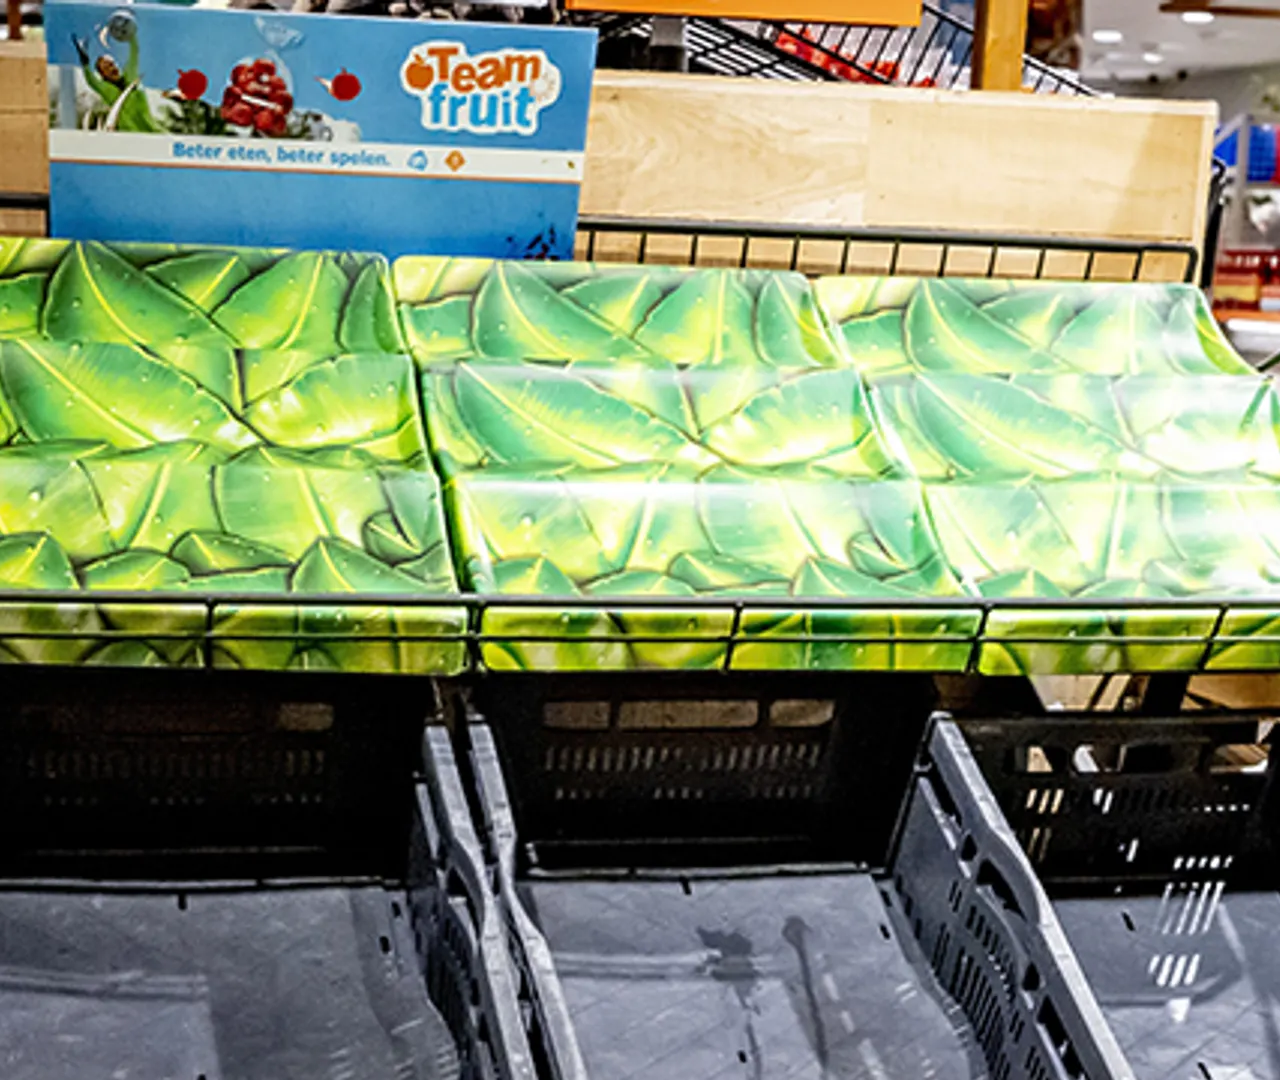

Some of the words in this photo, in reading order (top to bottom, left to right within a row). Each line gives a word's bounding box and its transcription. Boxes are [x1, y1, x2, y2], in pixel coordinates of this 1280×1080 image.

[427, 47, 541, 93] Team
[428, 83, 536, 127] fruit
[172, 141, 222, 159] Beter
[227, 145, 273, 164] eten,
[276, 145, 325, 163] beter
[330, 148, 392, 168] spelen.
